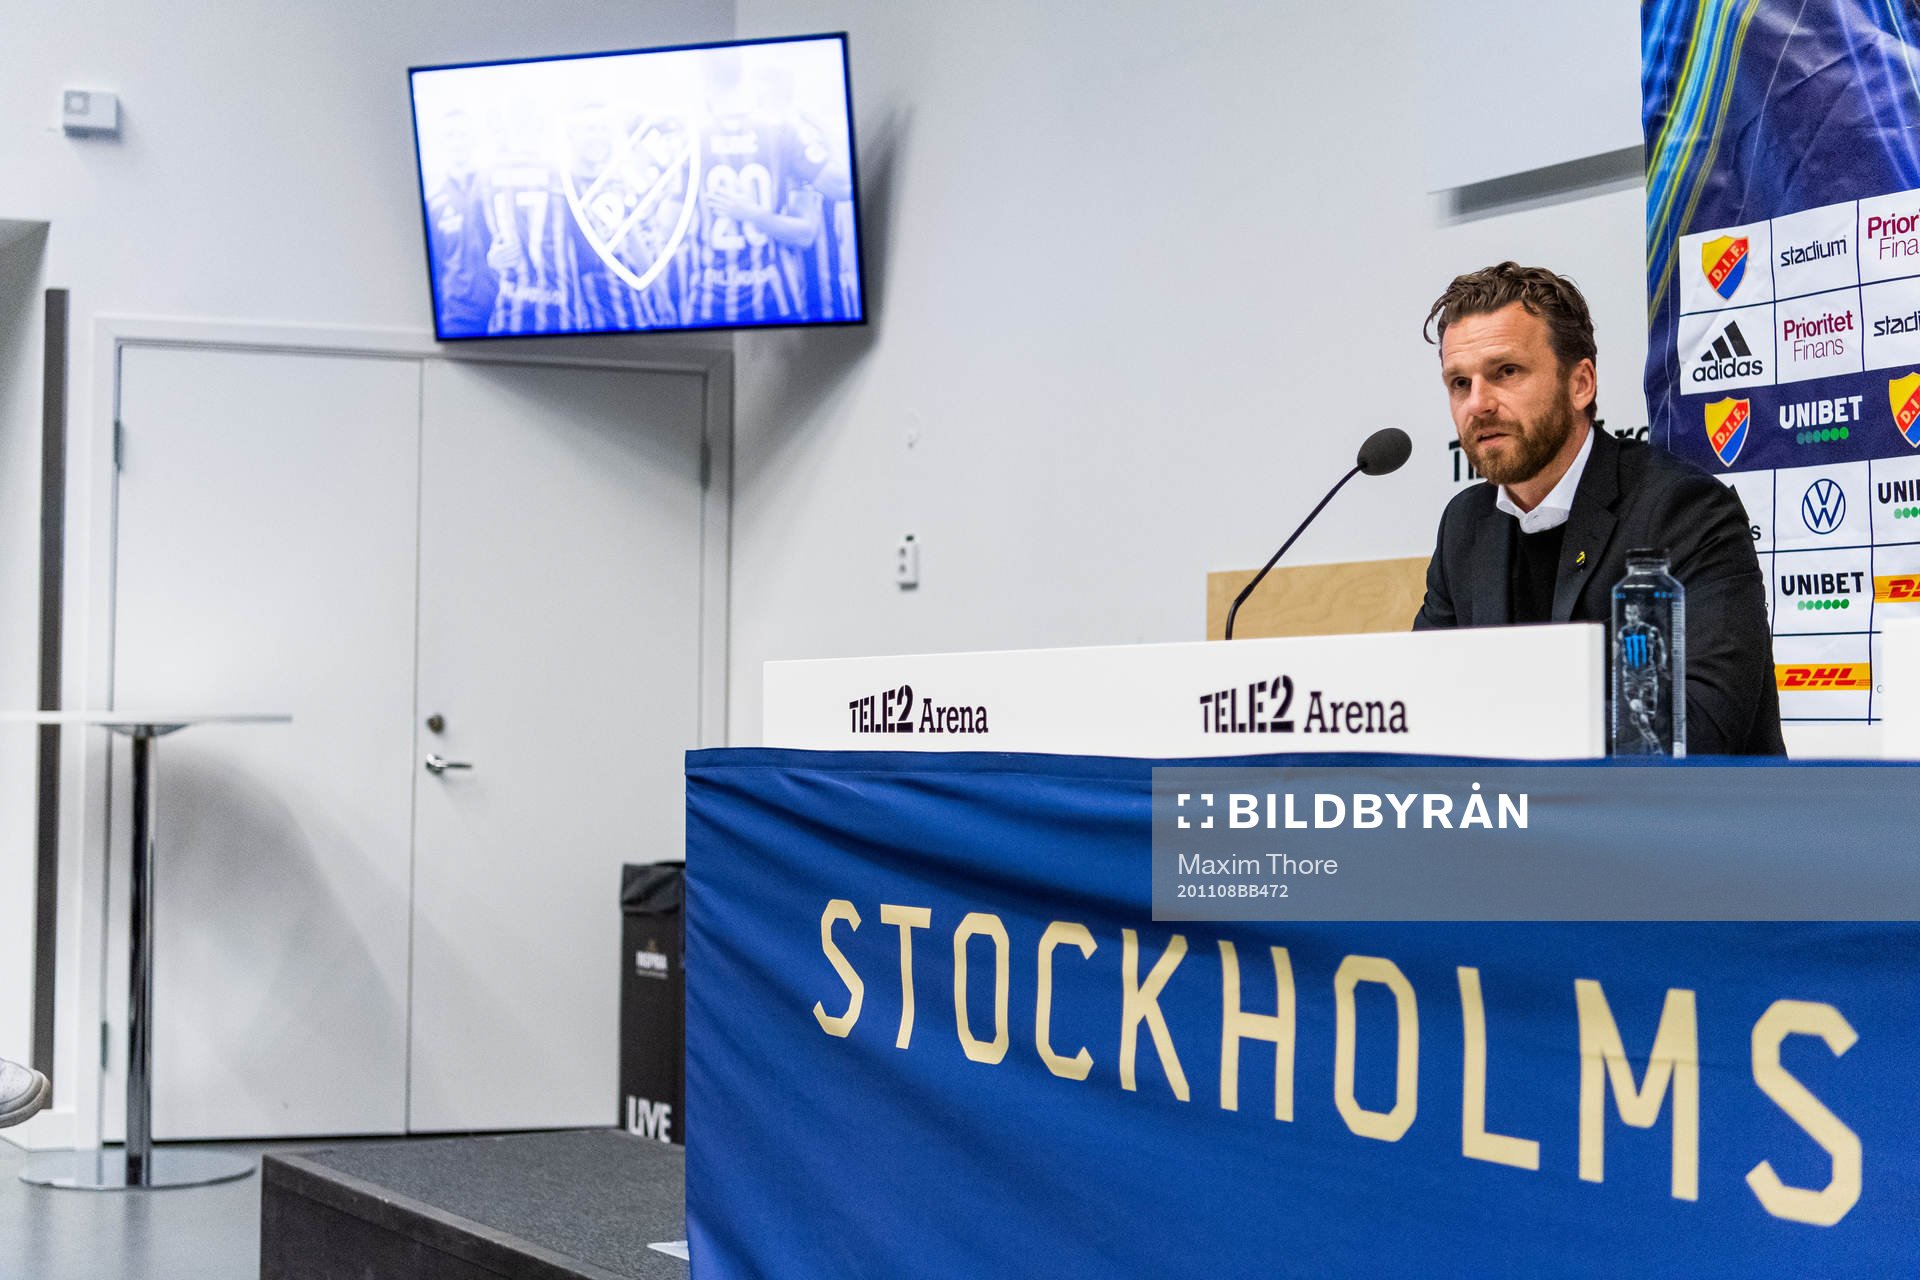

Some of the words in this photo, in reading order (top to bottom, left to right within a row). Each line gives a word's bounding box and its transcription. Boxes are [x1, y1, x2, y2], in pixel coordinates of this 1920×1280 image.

[1868, 208, 1920, 239] Prior
[1781, 238, 1847, 267] stadium
[1783, 310, 1854, 341] Prioritet
[1793, 338, 1844, 362] Finans
[1692, 359, 1763, 382] adidas
[1779, 396, 1863, 429] UNIBET
[1781, 572, 1864, 596] UNIBET
[1784, 668, 1857, 687] DHL
[849, 685, 914, 734] TELE2
[919, 699, 989, 734] Arena
[1200, 675, 1294, 734] TELE2
[1304, 691, 1409, 735] Arena
[812, 899, 1863, 1227] STOCKHOLMS
[627, 1094, 673, 1144] LIVE
